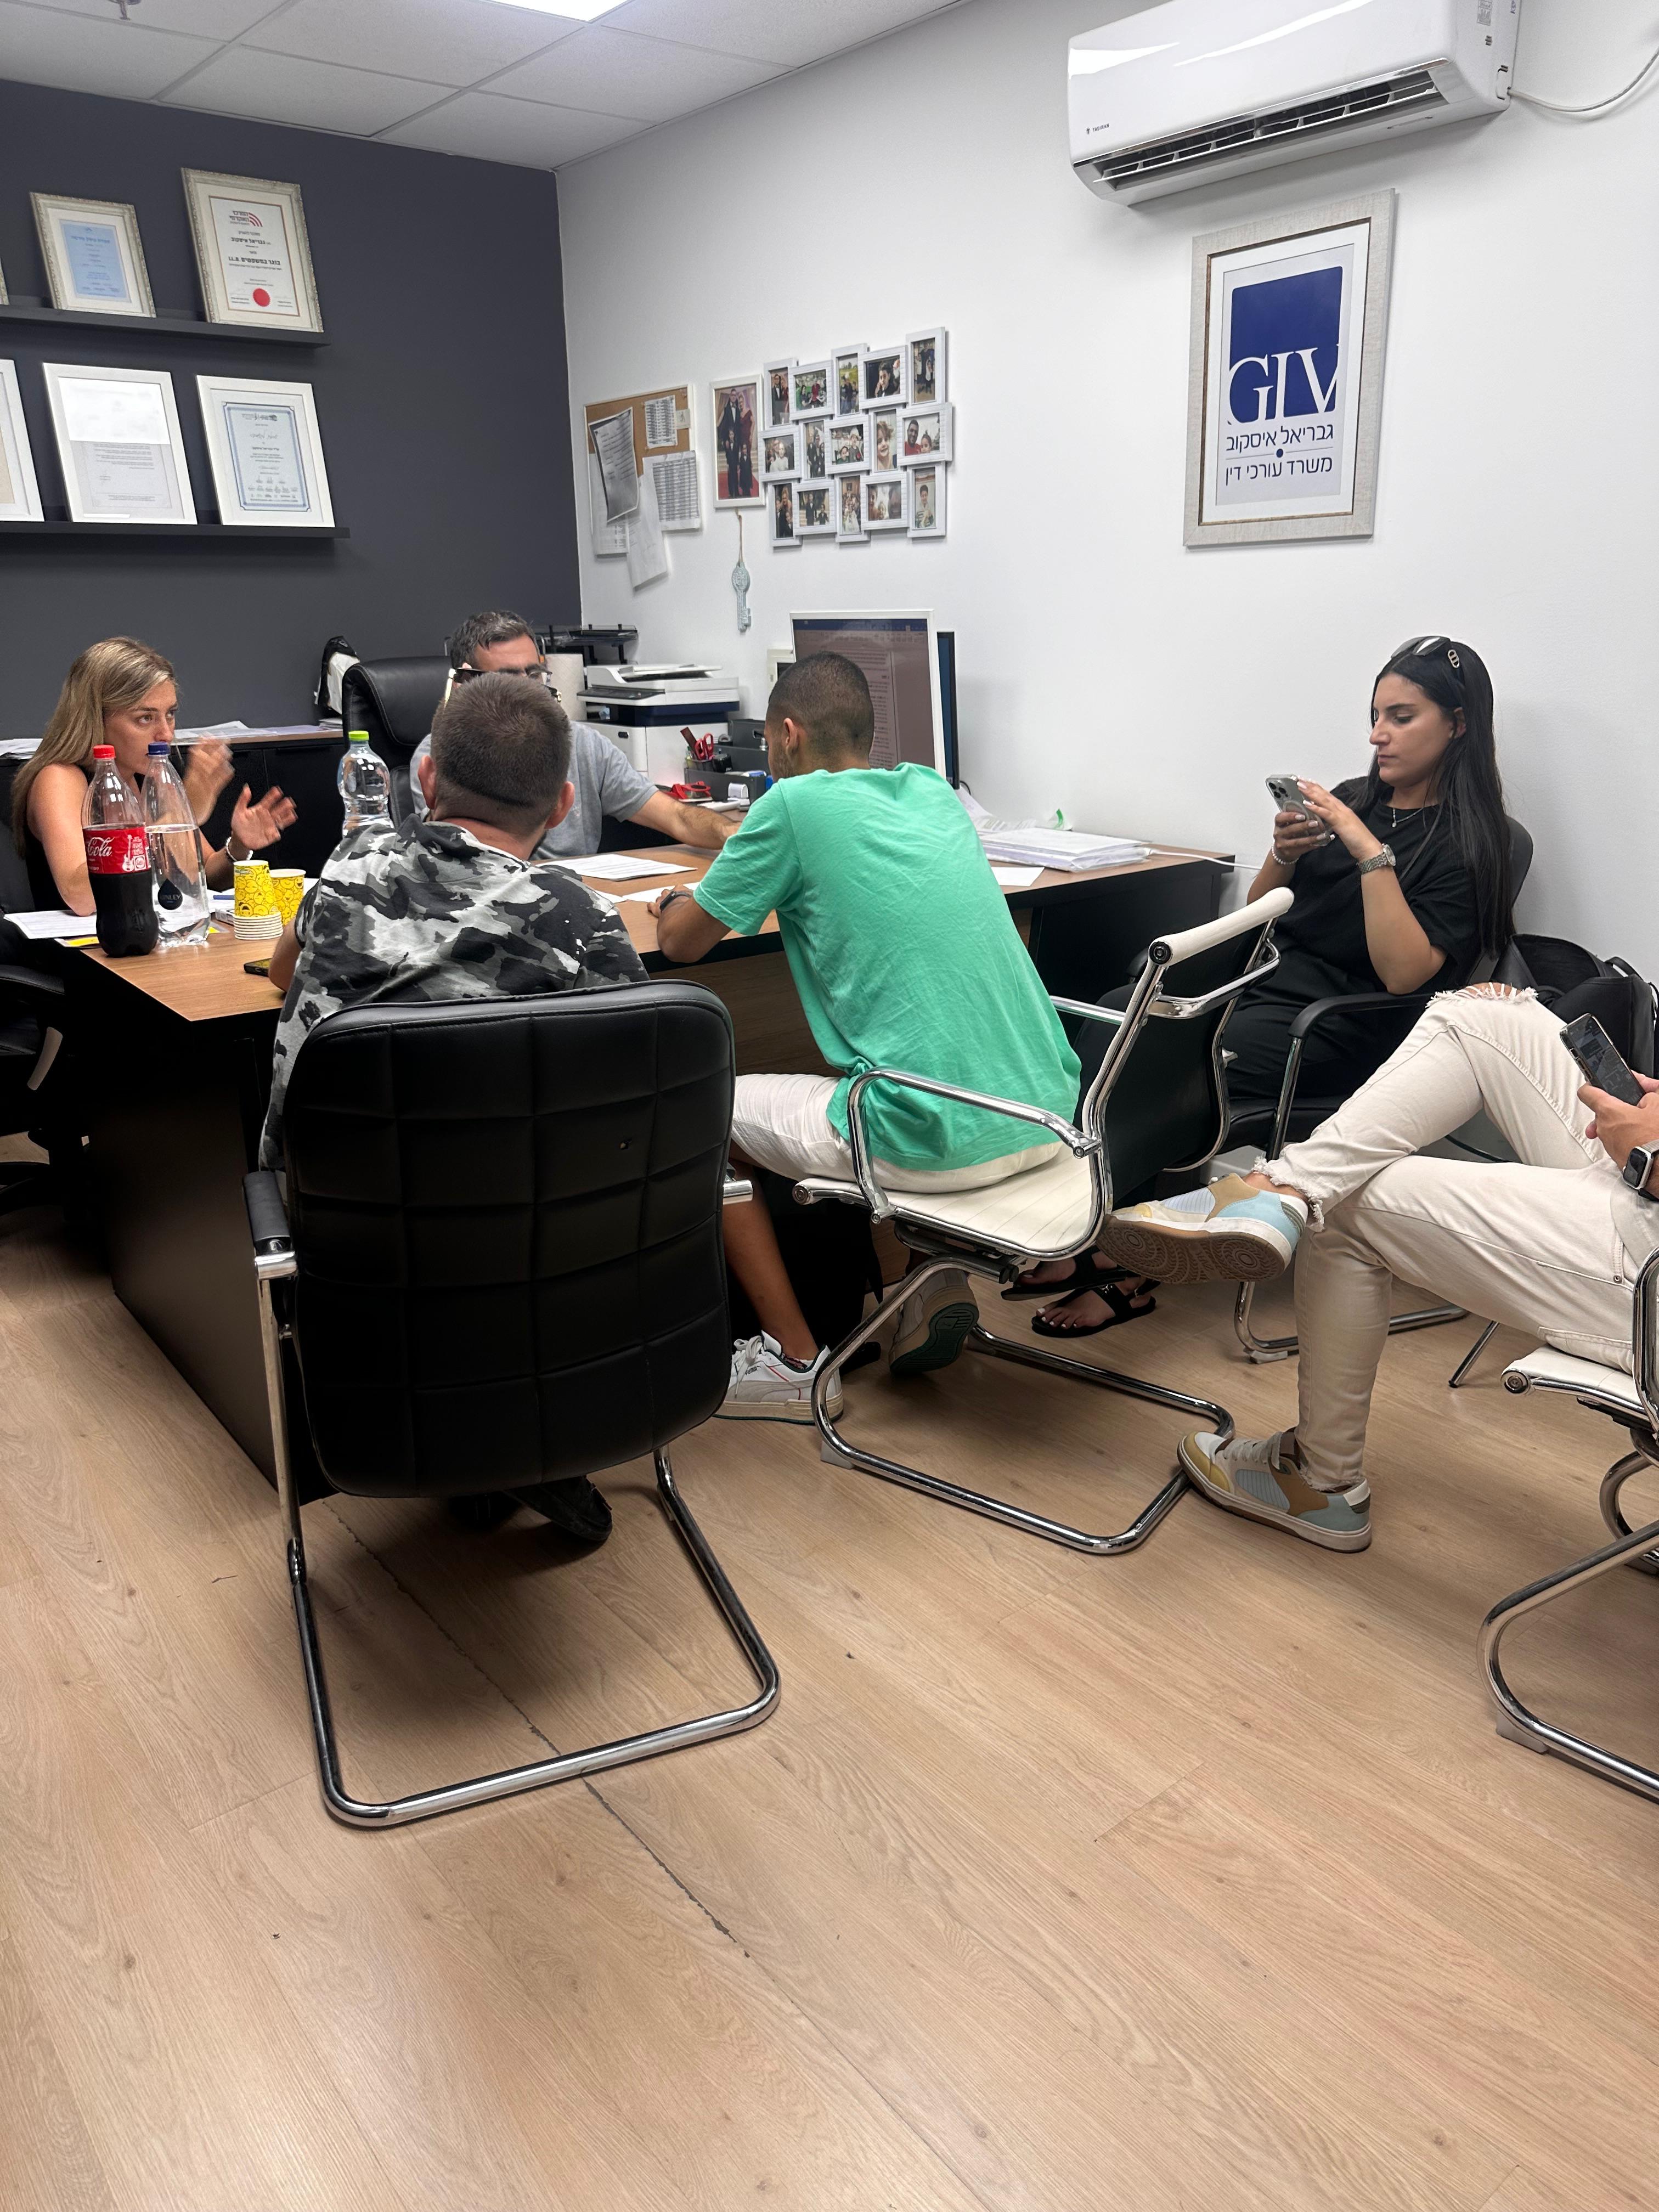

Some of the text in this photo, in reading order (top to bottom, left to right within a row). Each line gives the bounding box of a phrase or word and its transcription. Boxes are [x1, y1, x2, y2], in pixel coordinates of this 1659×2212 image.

[1092, 123, 1110, 132] TADIRAN
[1228, 345, 1339, 425] GIV
[1226, 424, 1334, 454] גבריאל איסקוב
[1226, 456, 1333, 486] משרד עורכי דין
[87, 837, 115, 857] Cola
[744, 1366, 758, 1375] PUMA
